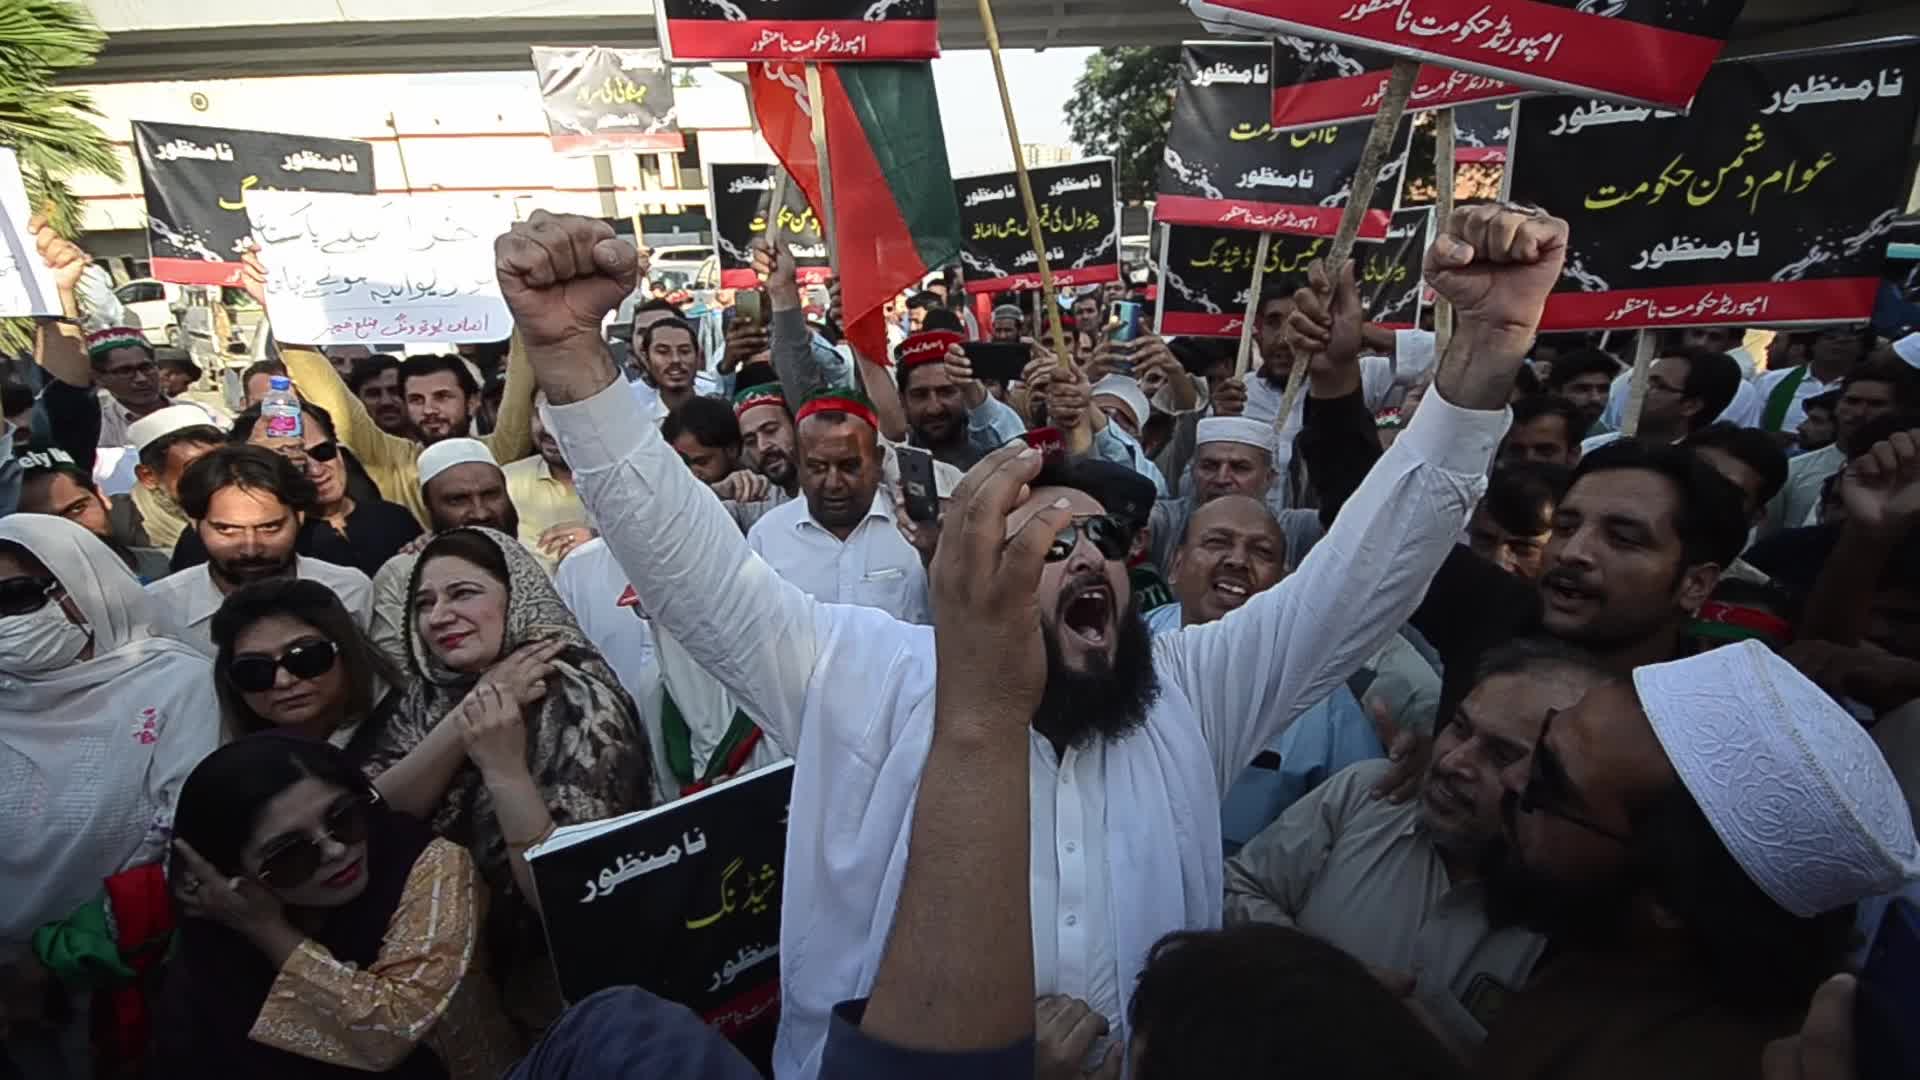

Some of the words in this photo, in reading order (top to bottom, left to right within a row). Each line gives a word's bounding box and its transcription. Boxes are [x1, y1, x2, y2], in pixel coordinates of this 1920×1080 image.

[787, 26, 831, 53] حکومت
[1408, 5, 1494, 43] حکومت
[1190, 62, 1270, 87] نامنظور
[1760, 69, 1903, 115] نامنظور
[1235, 167, 1315, 189] نامنظور
[1584, 153, 1695, 210] حکومت
[1686, 122, 1767, 207] دشمن
[1750, 152, 1837, 215] عوام
[1631, 231, 1760, 269] نامنظور
[1605, 298, 1656, 321] نامنظور
[1658, 291, 1719, 318] حکومت
[1712, 293, 1769, 316] امپورٹڈ
[579, 827, 708, 903] نامنظور
